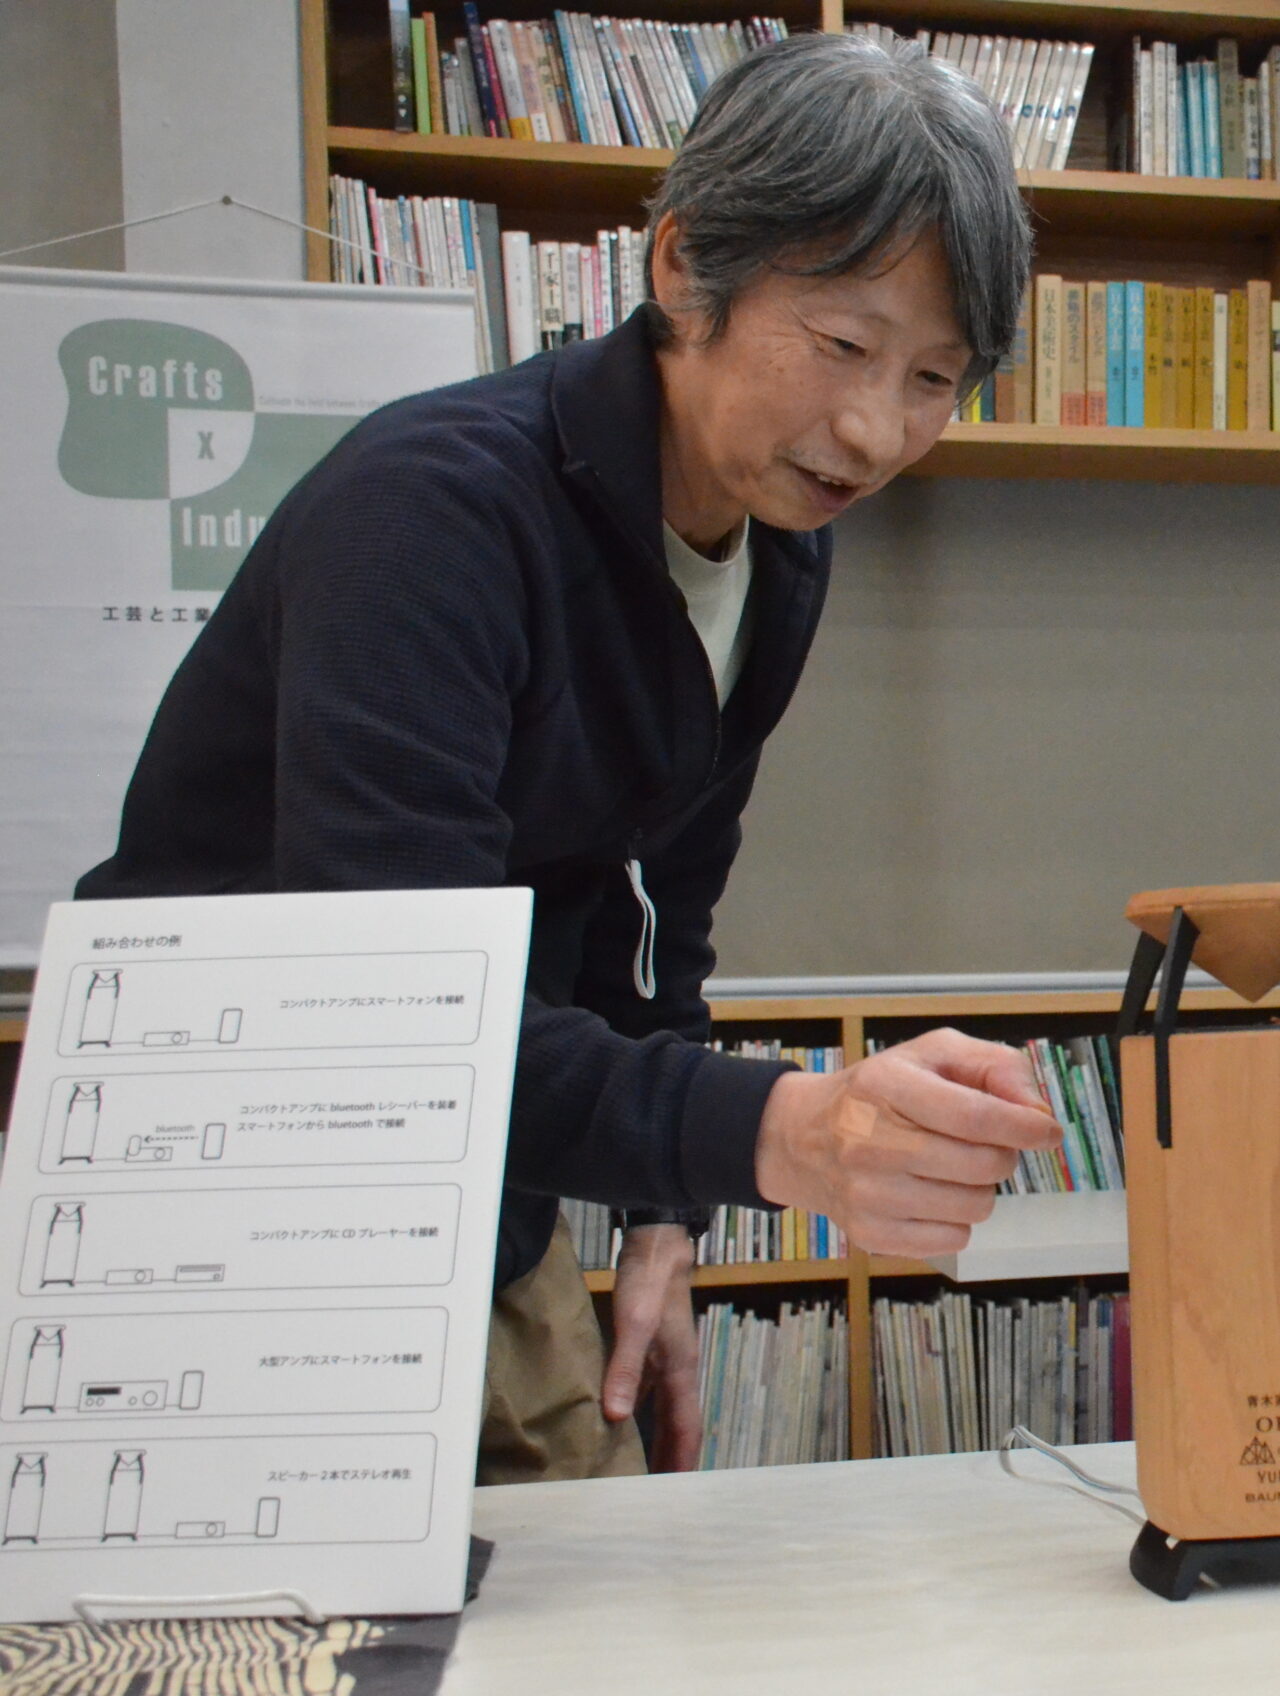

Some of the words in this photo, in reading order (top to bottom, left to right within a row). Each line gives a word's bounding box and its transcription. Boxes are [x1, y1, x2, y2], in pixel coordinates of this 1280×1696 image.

[87, 355, 223, 401] Crafts
[92, 934, 183, 950] 組み合わせの例
[330, 1102, 376, 1112] bluetooth
[328, 1119, 374, 1130] bluetooth
